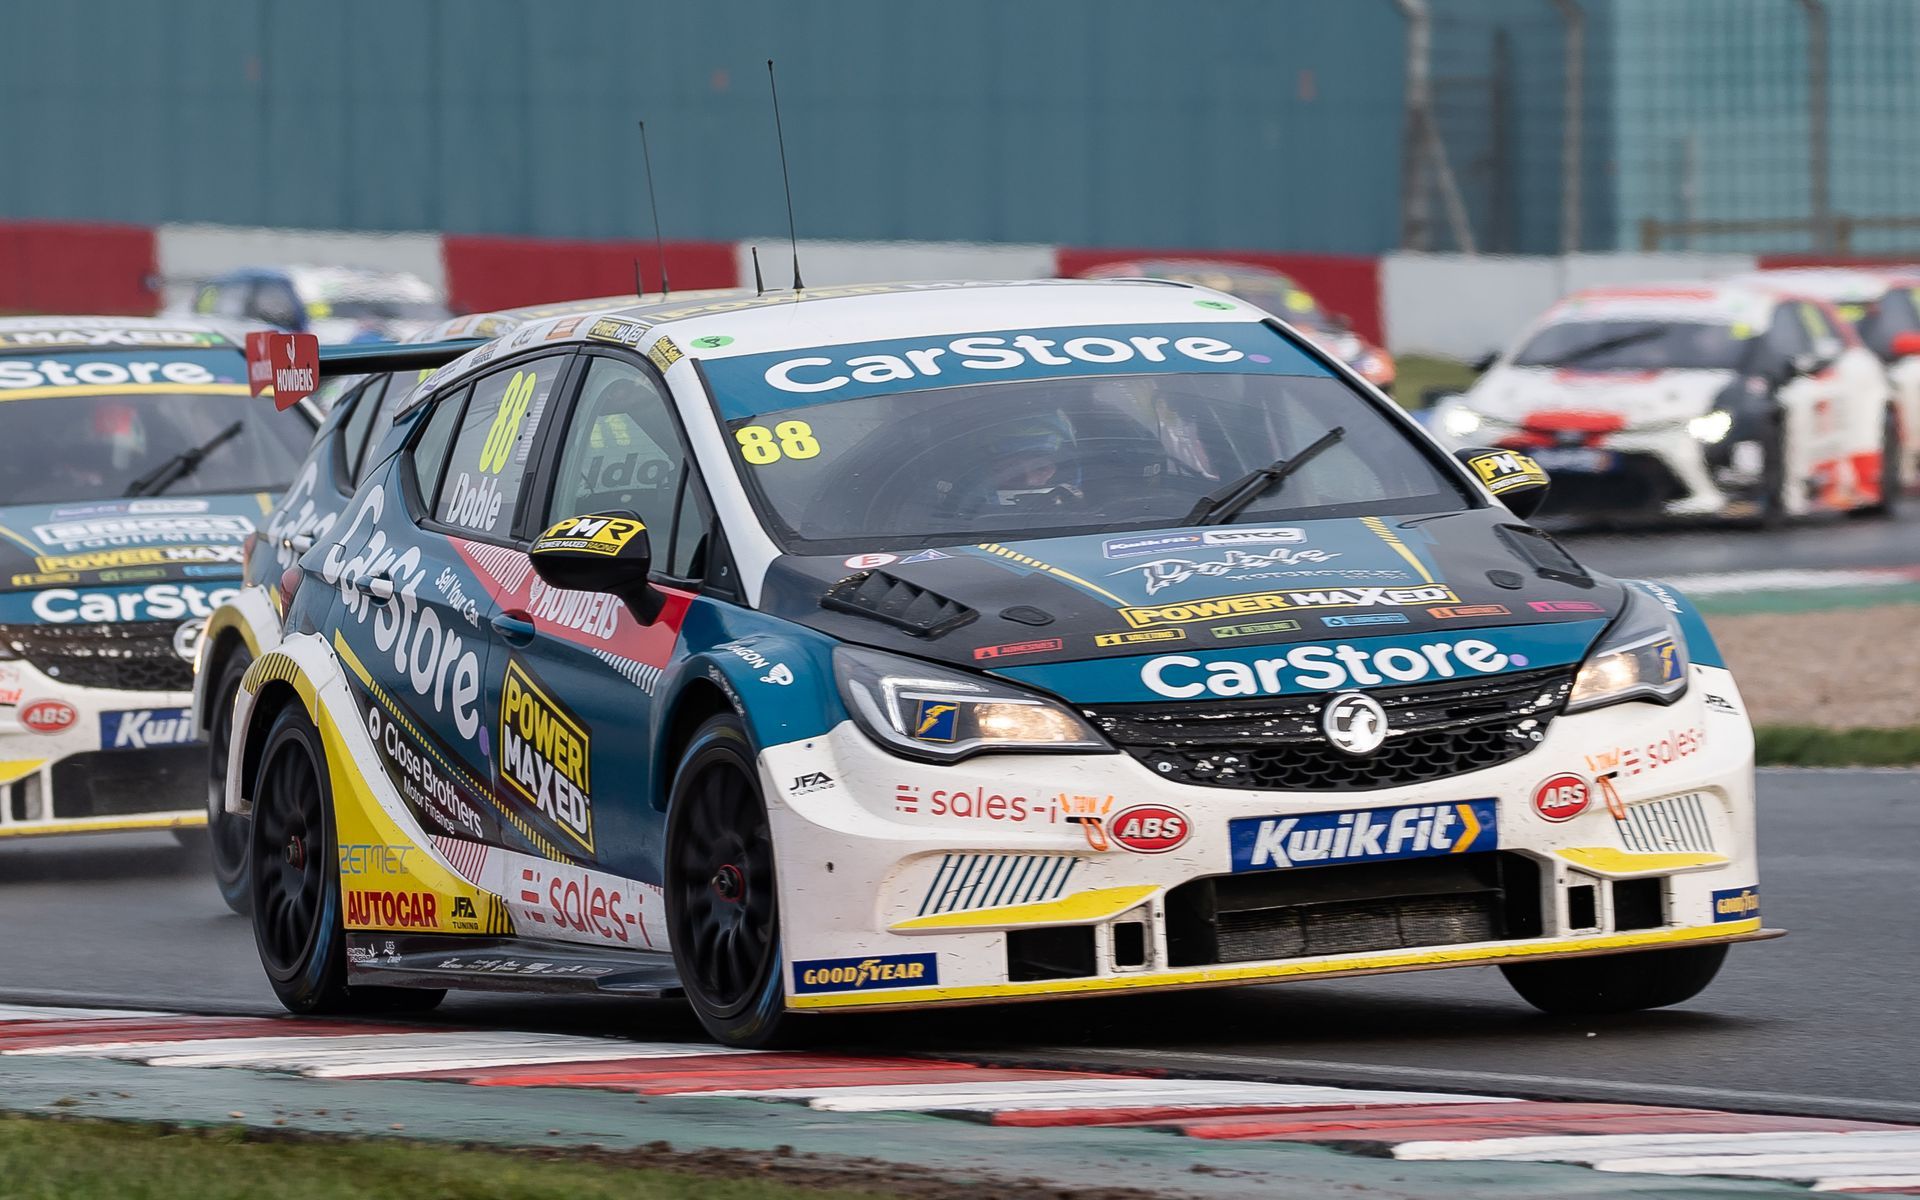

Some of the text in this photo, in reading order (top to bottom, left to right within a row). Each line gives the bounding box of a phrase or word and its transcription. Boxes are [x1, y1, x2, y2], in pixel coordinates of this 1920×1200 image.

[13, 330, 196, 345] MAXED
[277, 368, 314, 392] HOWDENS
[479, 370, 537, 474] 88
[735, 420, 821, 465] 88
[446, 472, 502, 531] Doble
[546, 518, 634, 540] PMR
[1210, 531, 1294, 541] BTCC
[45, 545, 244, 571] POWER MAX
[560, 540, 588, 548] MAXED
[586, 541, 617, 553] RACING
[435, 567, 457, 594] Sell
[446, 579, 467, 612] Your
[1135, 587, 1448, 624] POWER MAXED
[534, 585, 625, 640] HOWDENS
[27, 706, 71, 724] ABS
[505, 676, 583, 790] POWER
[385, 722, 483, 839] Close Brothers
[505, 724, 587, 834] MAXED
[789, 771, 834, 790] JFA
[404, 776, 455, 834] Motor Finance
[930, 786, 1057, 824] sales-i
[1541, 783, 1588, 812] ABS
[1119, 810, 1183, 840] ABS
[348, 891, 438, 928] AUTOCAR
[451, 896, 477, 918] JFA
[549, 873, 653, 948] sales-i
[452, 921, 479, 931] TUNING
[803, 959, 925, 987] GOODYEAR
